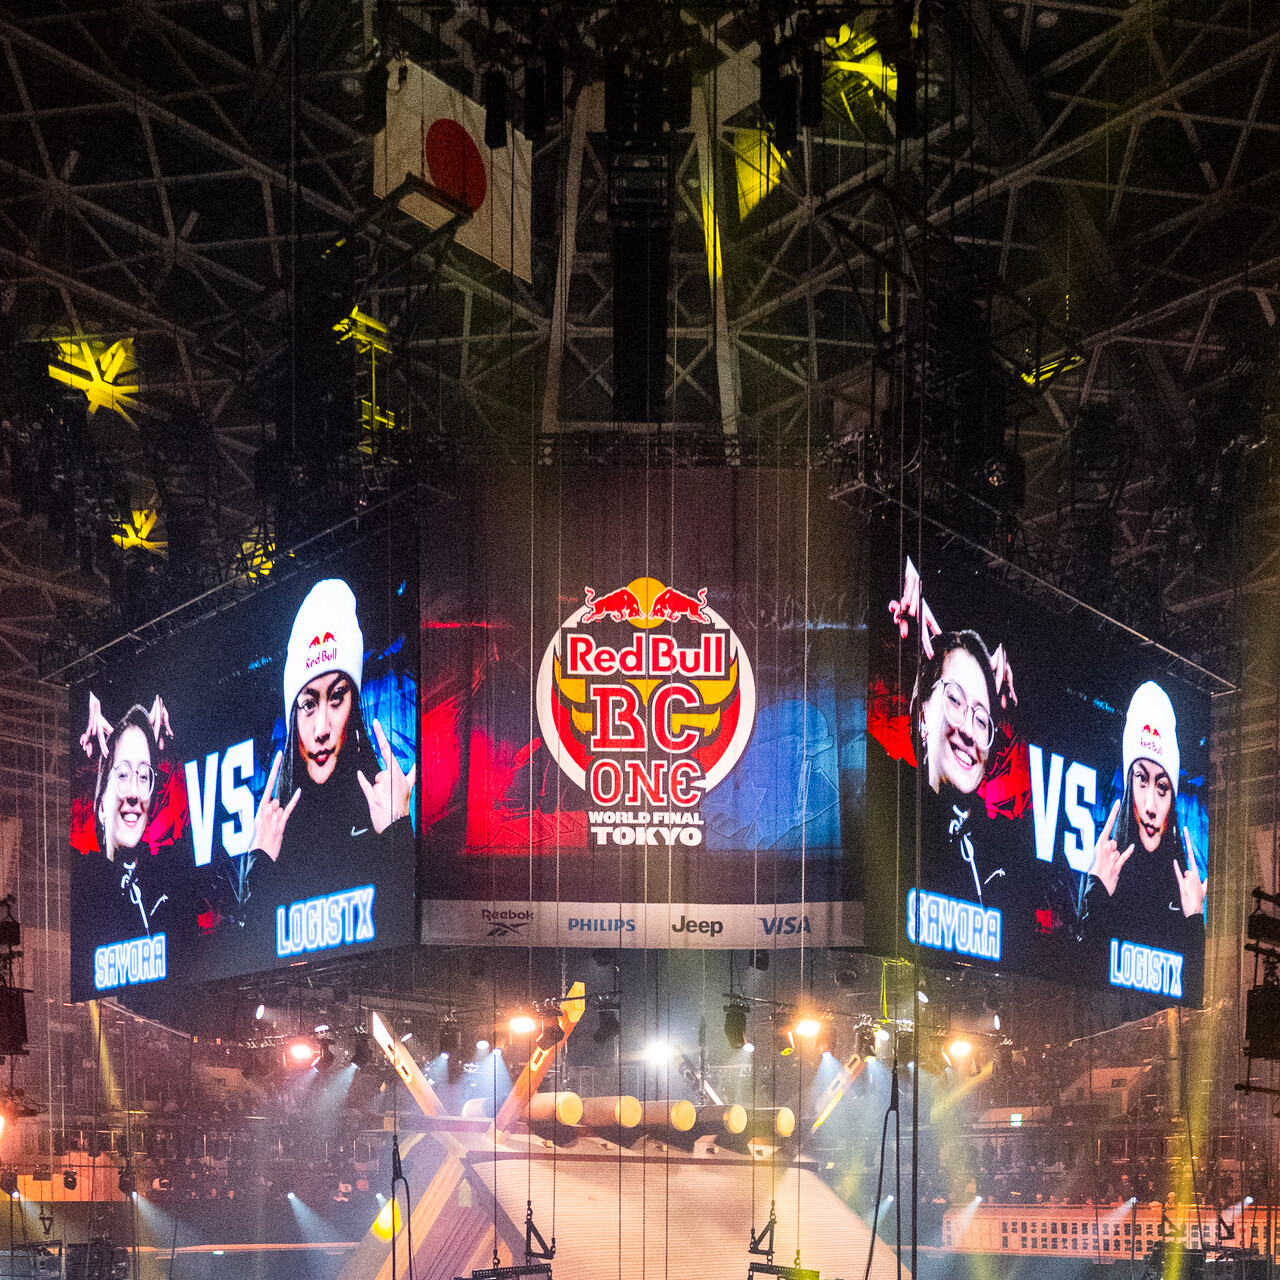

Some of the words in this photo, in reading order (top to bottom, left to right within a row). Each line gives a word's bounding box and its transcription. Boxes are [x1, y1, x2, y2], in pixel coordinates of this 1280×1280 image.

[305, 650, 321, 670] Red
[321, 647, 338, 663] Bull
[567, 634, 644, 676] Red
[649, 634, 725, 676] Bull
[590, 683, 701, 753] BC
[185, 739, 256, 867] VS
[589, 812, 650, 825] WORLD
[653, 812, 704, 825] FINAL
[1028, 744, 1097, 873] VS
[591, 826, 702, 846] TOKYO
[277, 885, 376, 957] LOGISTX
[481, 909, 534, 920] Reebok
[568, 917, 635, 932] PHILIPS
[672, 915, 724, 937] Jeep
[758, 916, 812, 935] VISA
[907, 888, 1002, 961] SAYORA
[95, 933, 168, 989] SAYORA
[1109, 939, 1183, 998] LOGISTX
